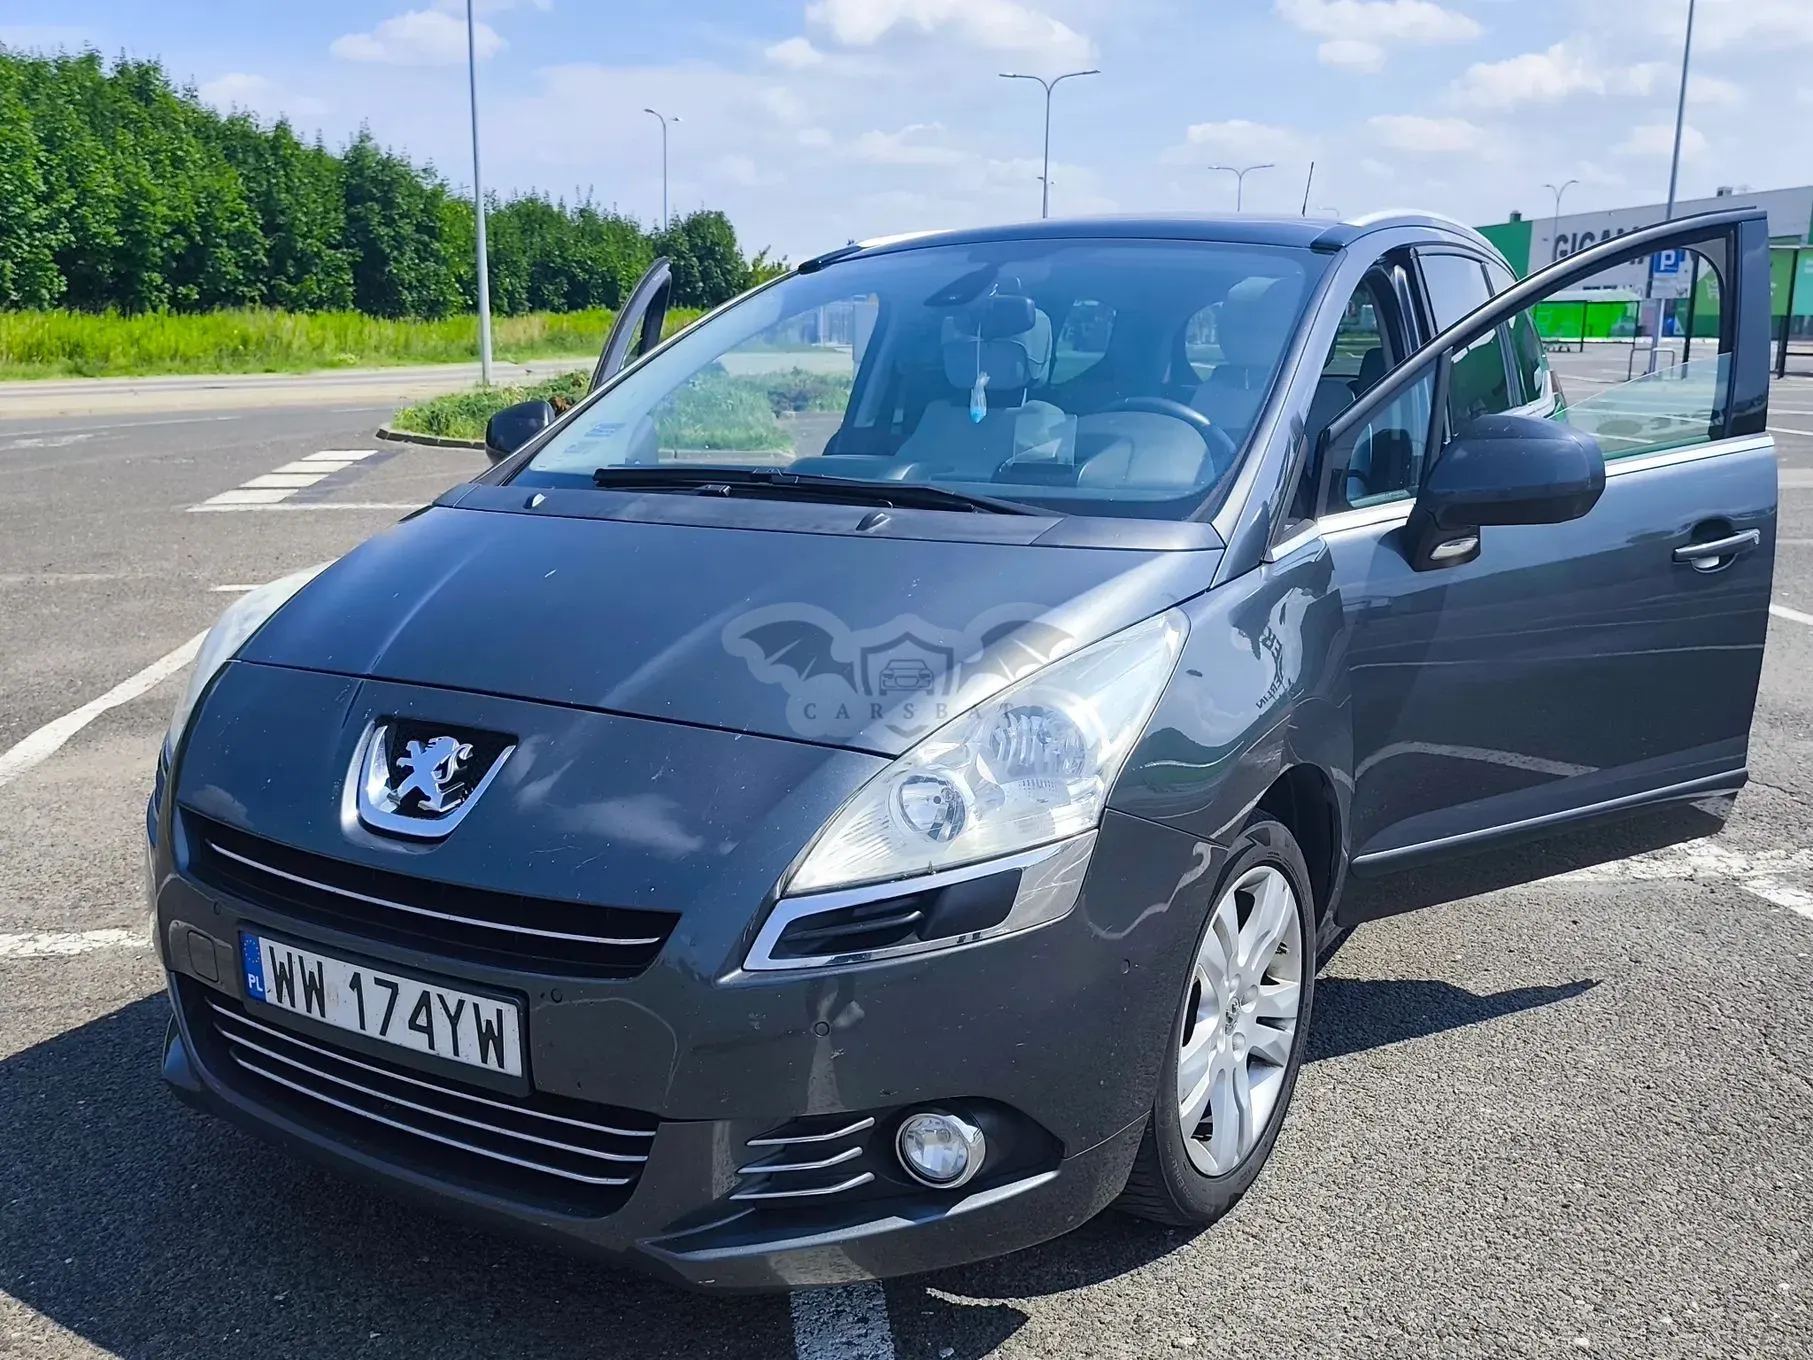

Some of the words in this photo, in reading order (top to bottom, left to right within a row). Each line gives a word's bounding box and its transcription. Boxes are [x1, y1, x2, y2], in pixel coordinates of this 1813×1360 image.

[1660, 249, 1675, 270] P
[247, 973, 263, 992] PL
[268, 945, 326, 1018] WW
[348, 971, 505, 1069] 174YW
